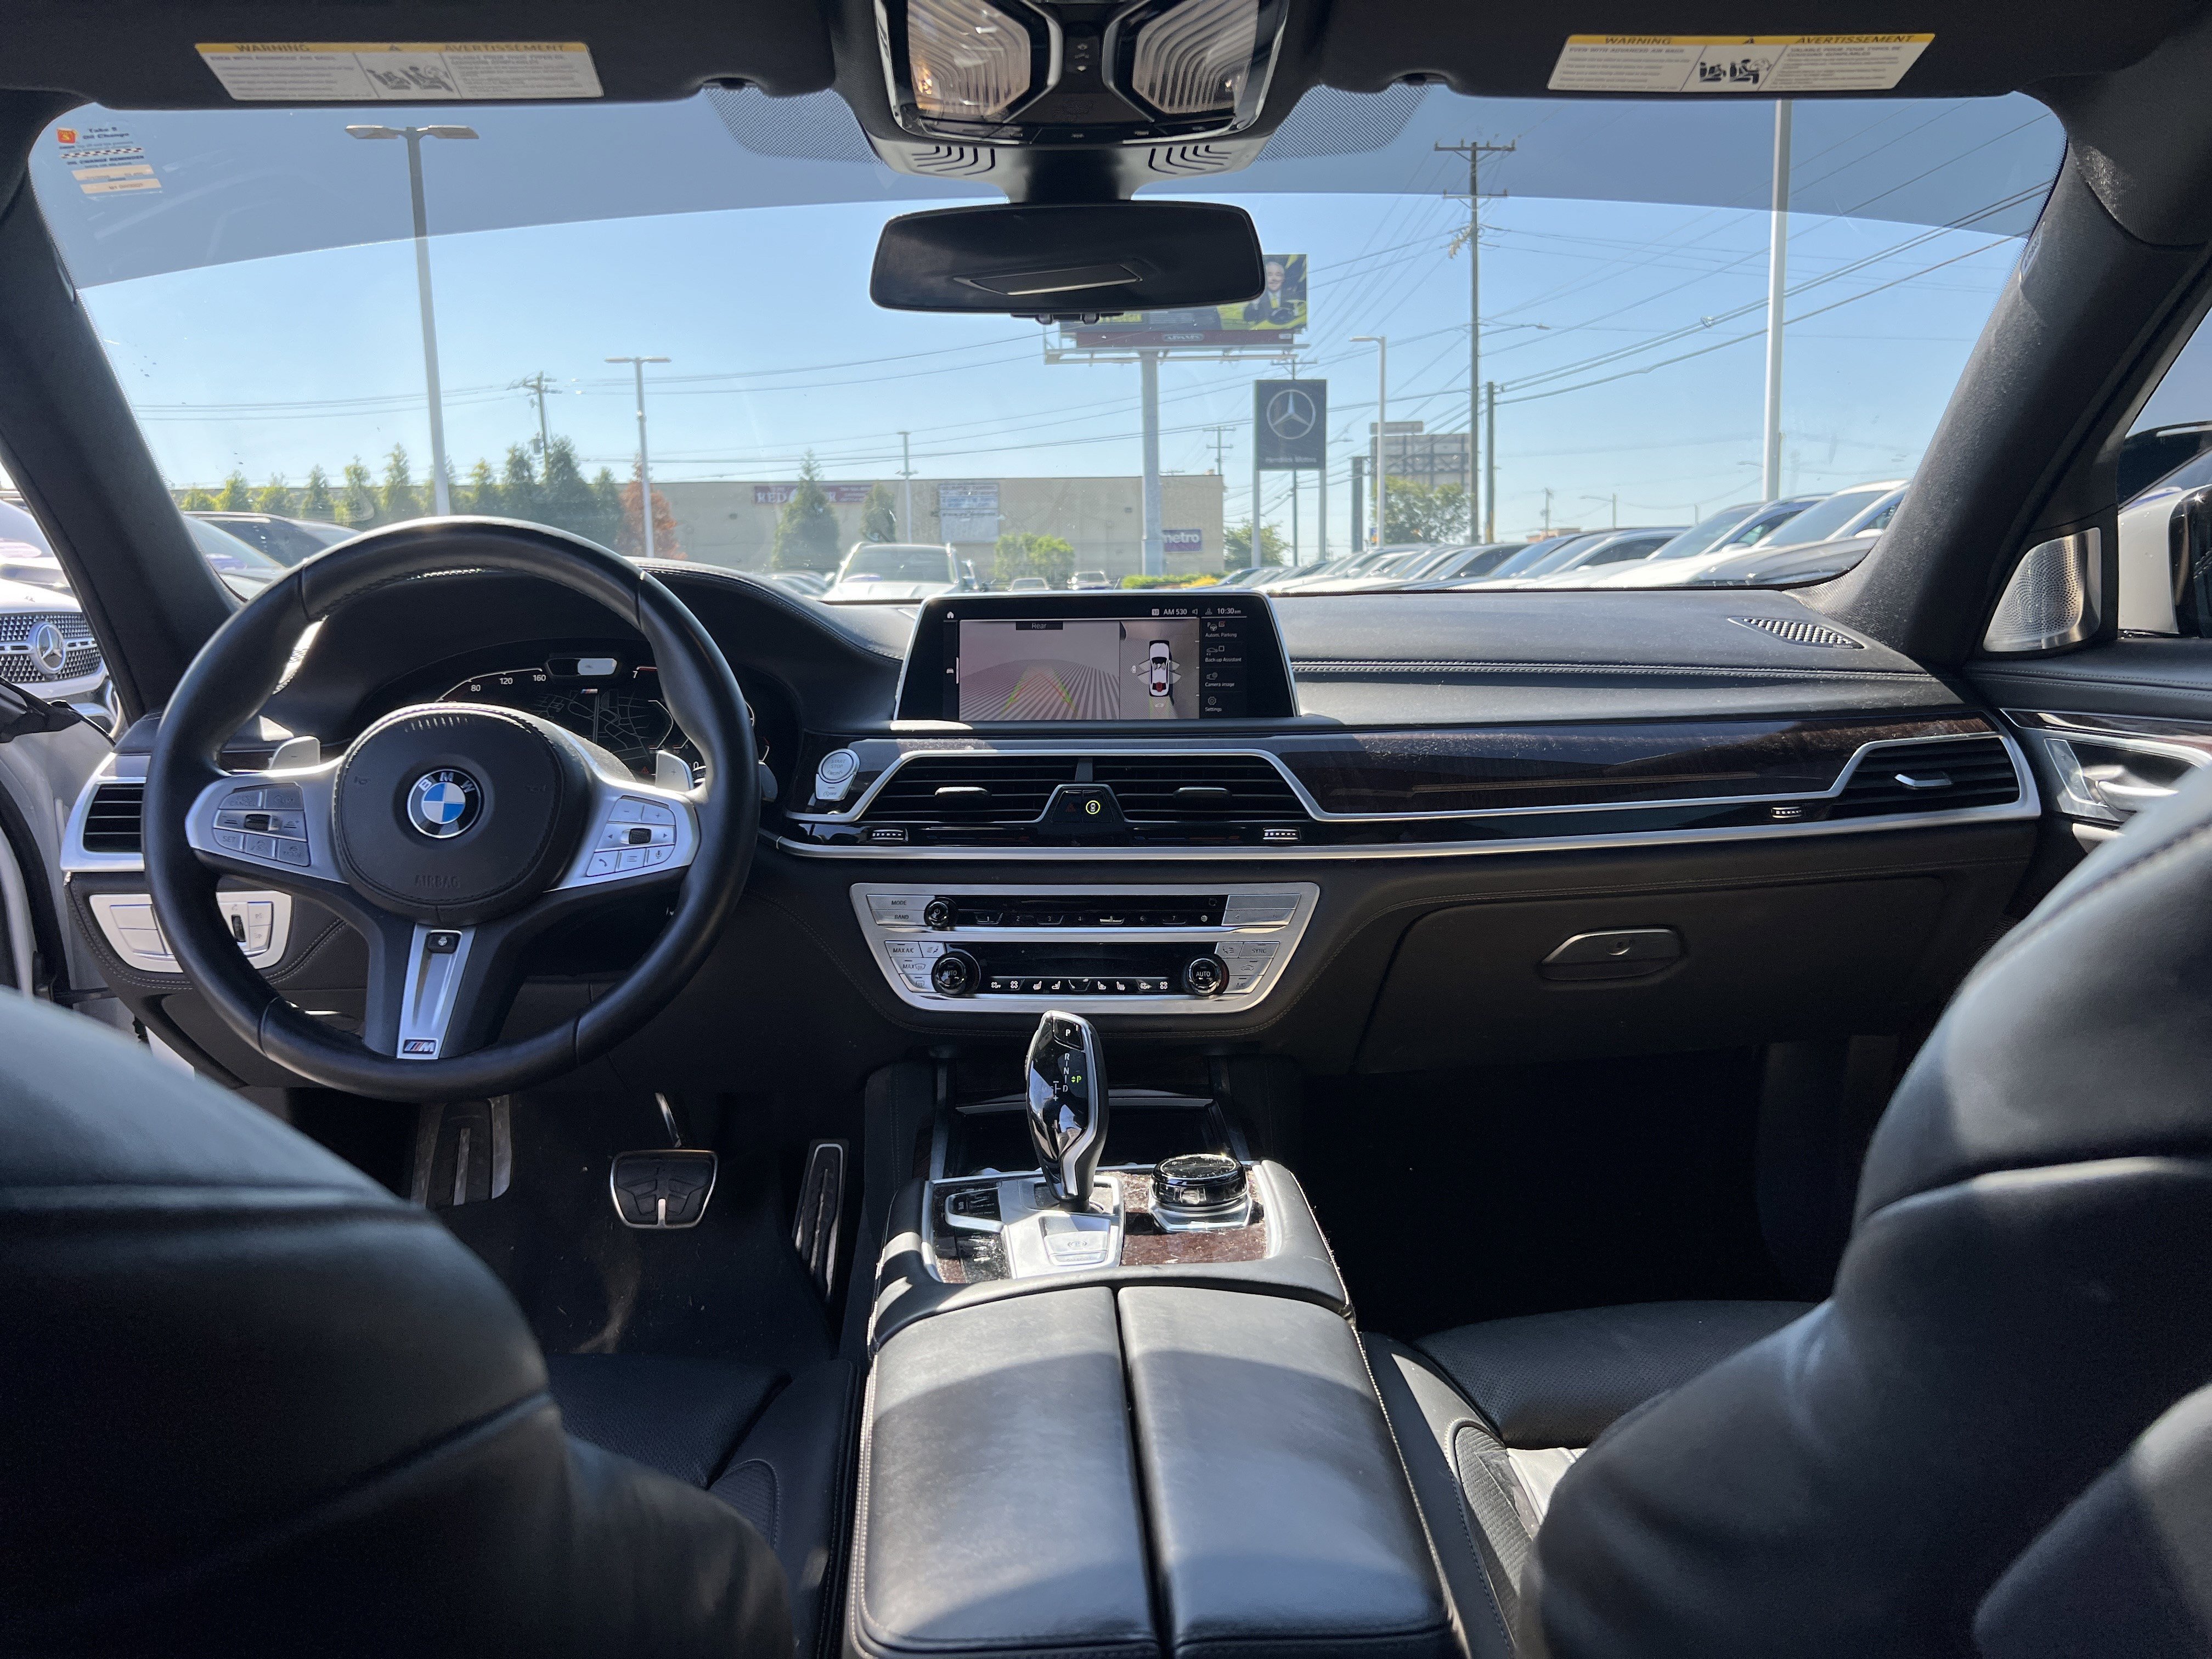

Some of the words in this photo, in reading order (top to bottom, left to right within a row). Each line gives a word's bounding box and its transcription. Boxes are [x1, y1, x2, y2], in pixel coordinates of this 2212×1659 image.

[235, 43, 310, 52] WARNING
[757, 492, 787, 504] RED
[419, 772, 476, 793] BMW
